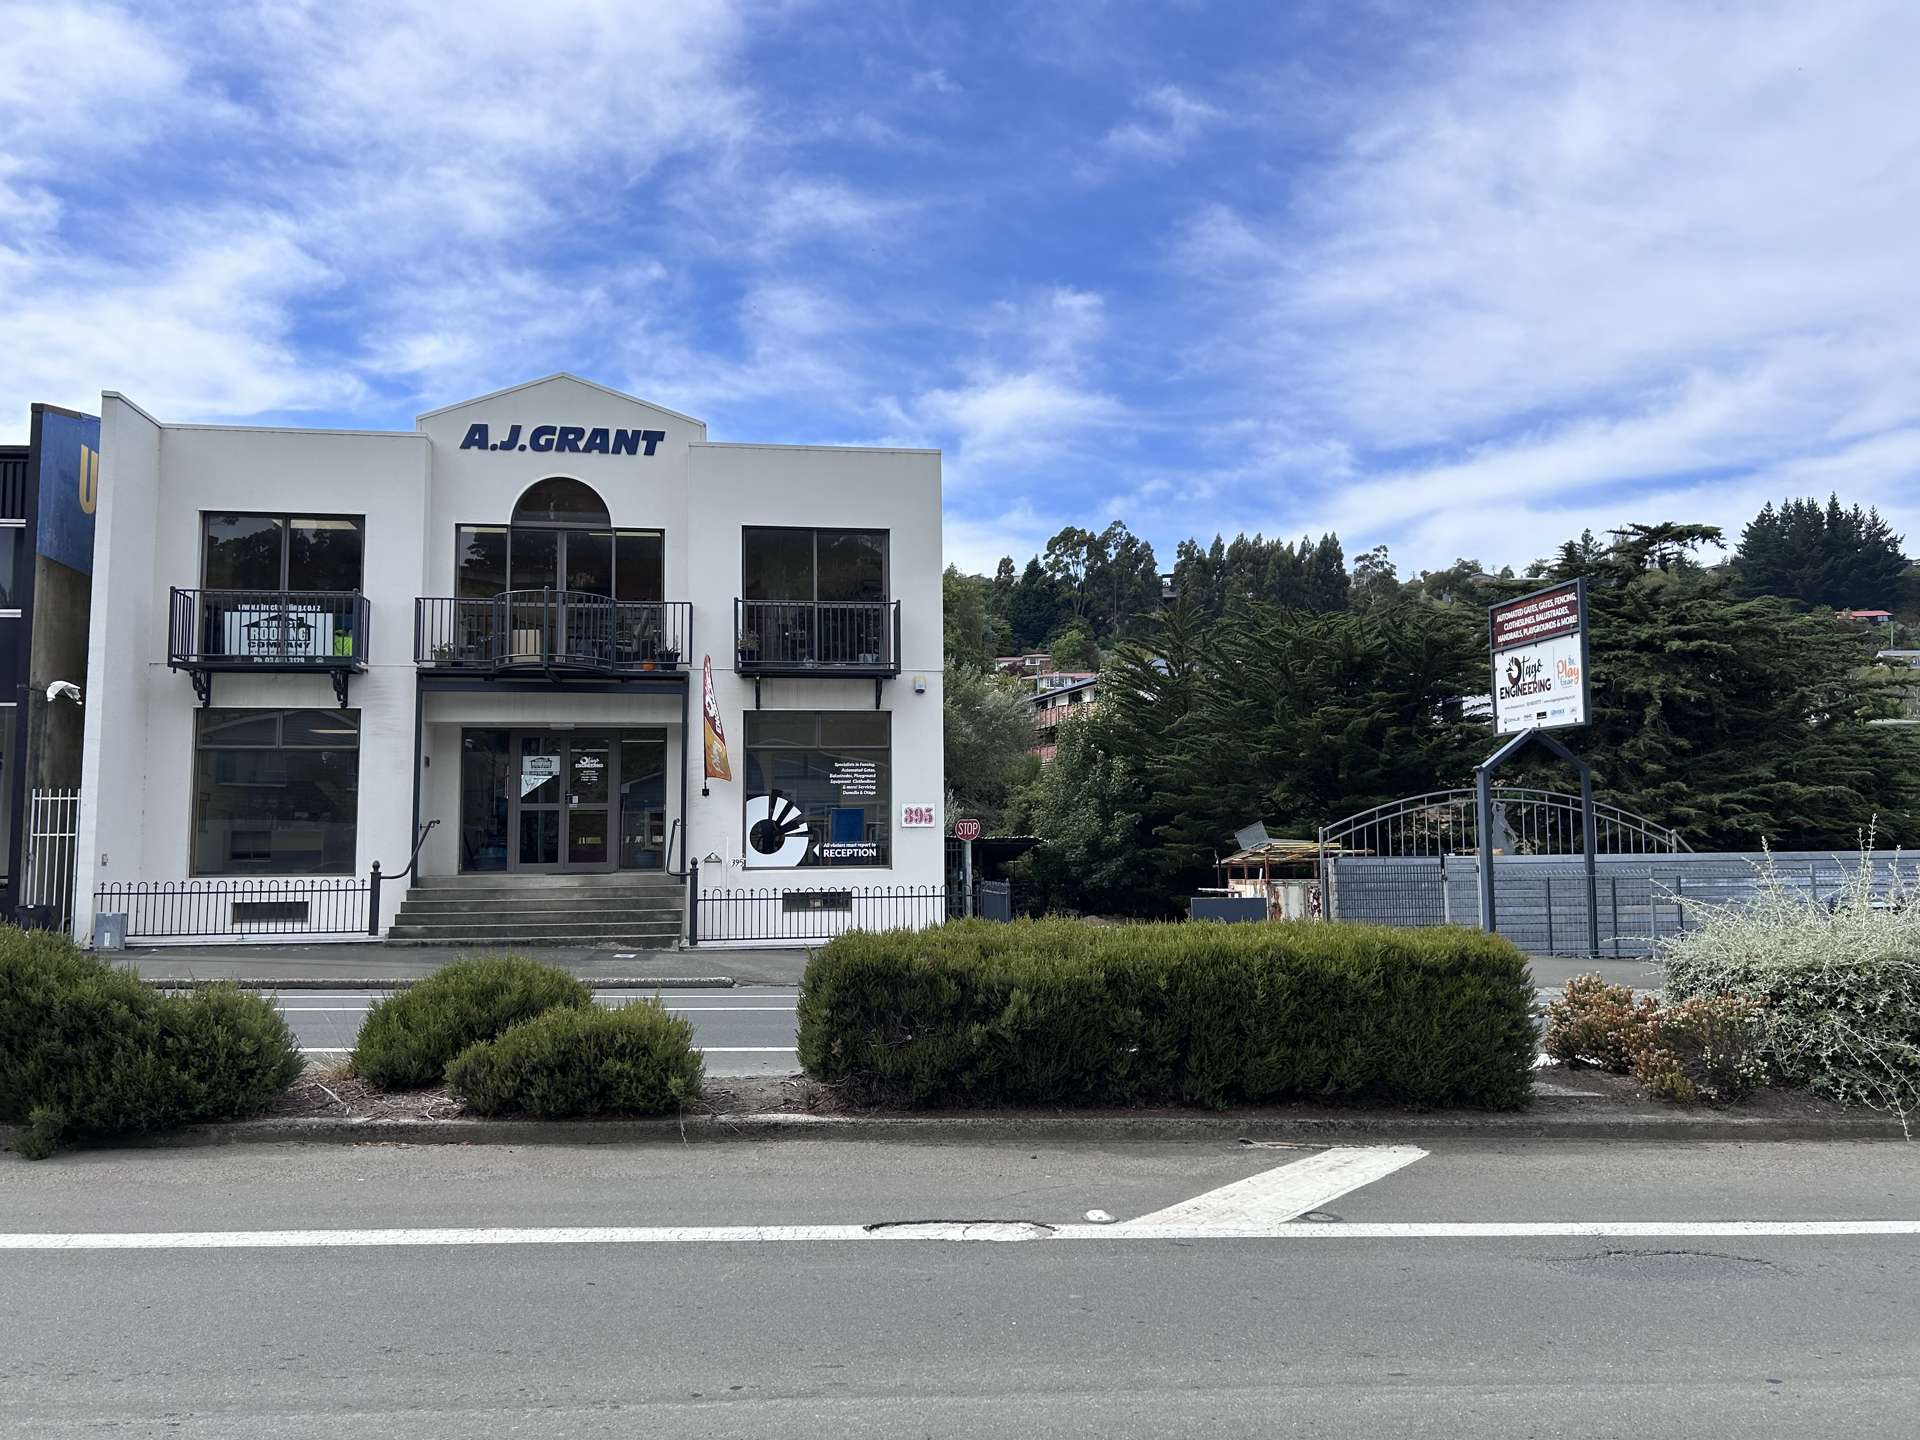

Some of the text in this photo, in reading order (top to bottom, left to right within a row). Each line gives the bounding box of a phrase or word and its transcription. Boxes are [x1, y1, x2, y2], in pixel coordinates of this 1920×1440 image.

[459, 423, 666, 456] A.J.GRANT
[1496, 607, 1524, 622] AUTOMATED
[1554, 592, 1577, 606] FENCING,
[1497, 630, 1524, 643] HANDRAILS,
[1523, 621, 1557, 636] PLAYGROUNDS
[1500, 678, 1552, 699] ENGINEERING
[904, 807, 934, 825] 395
[958, 822, 978, 835] STOP
[823, 848, 877, 857] RECEPTION
